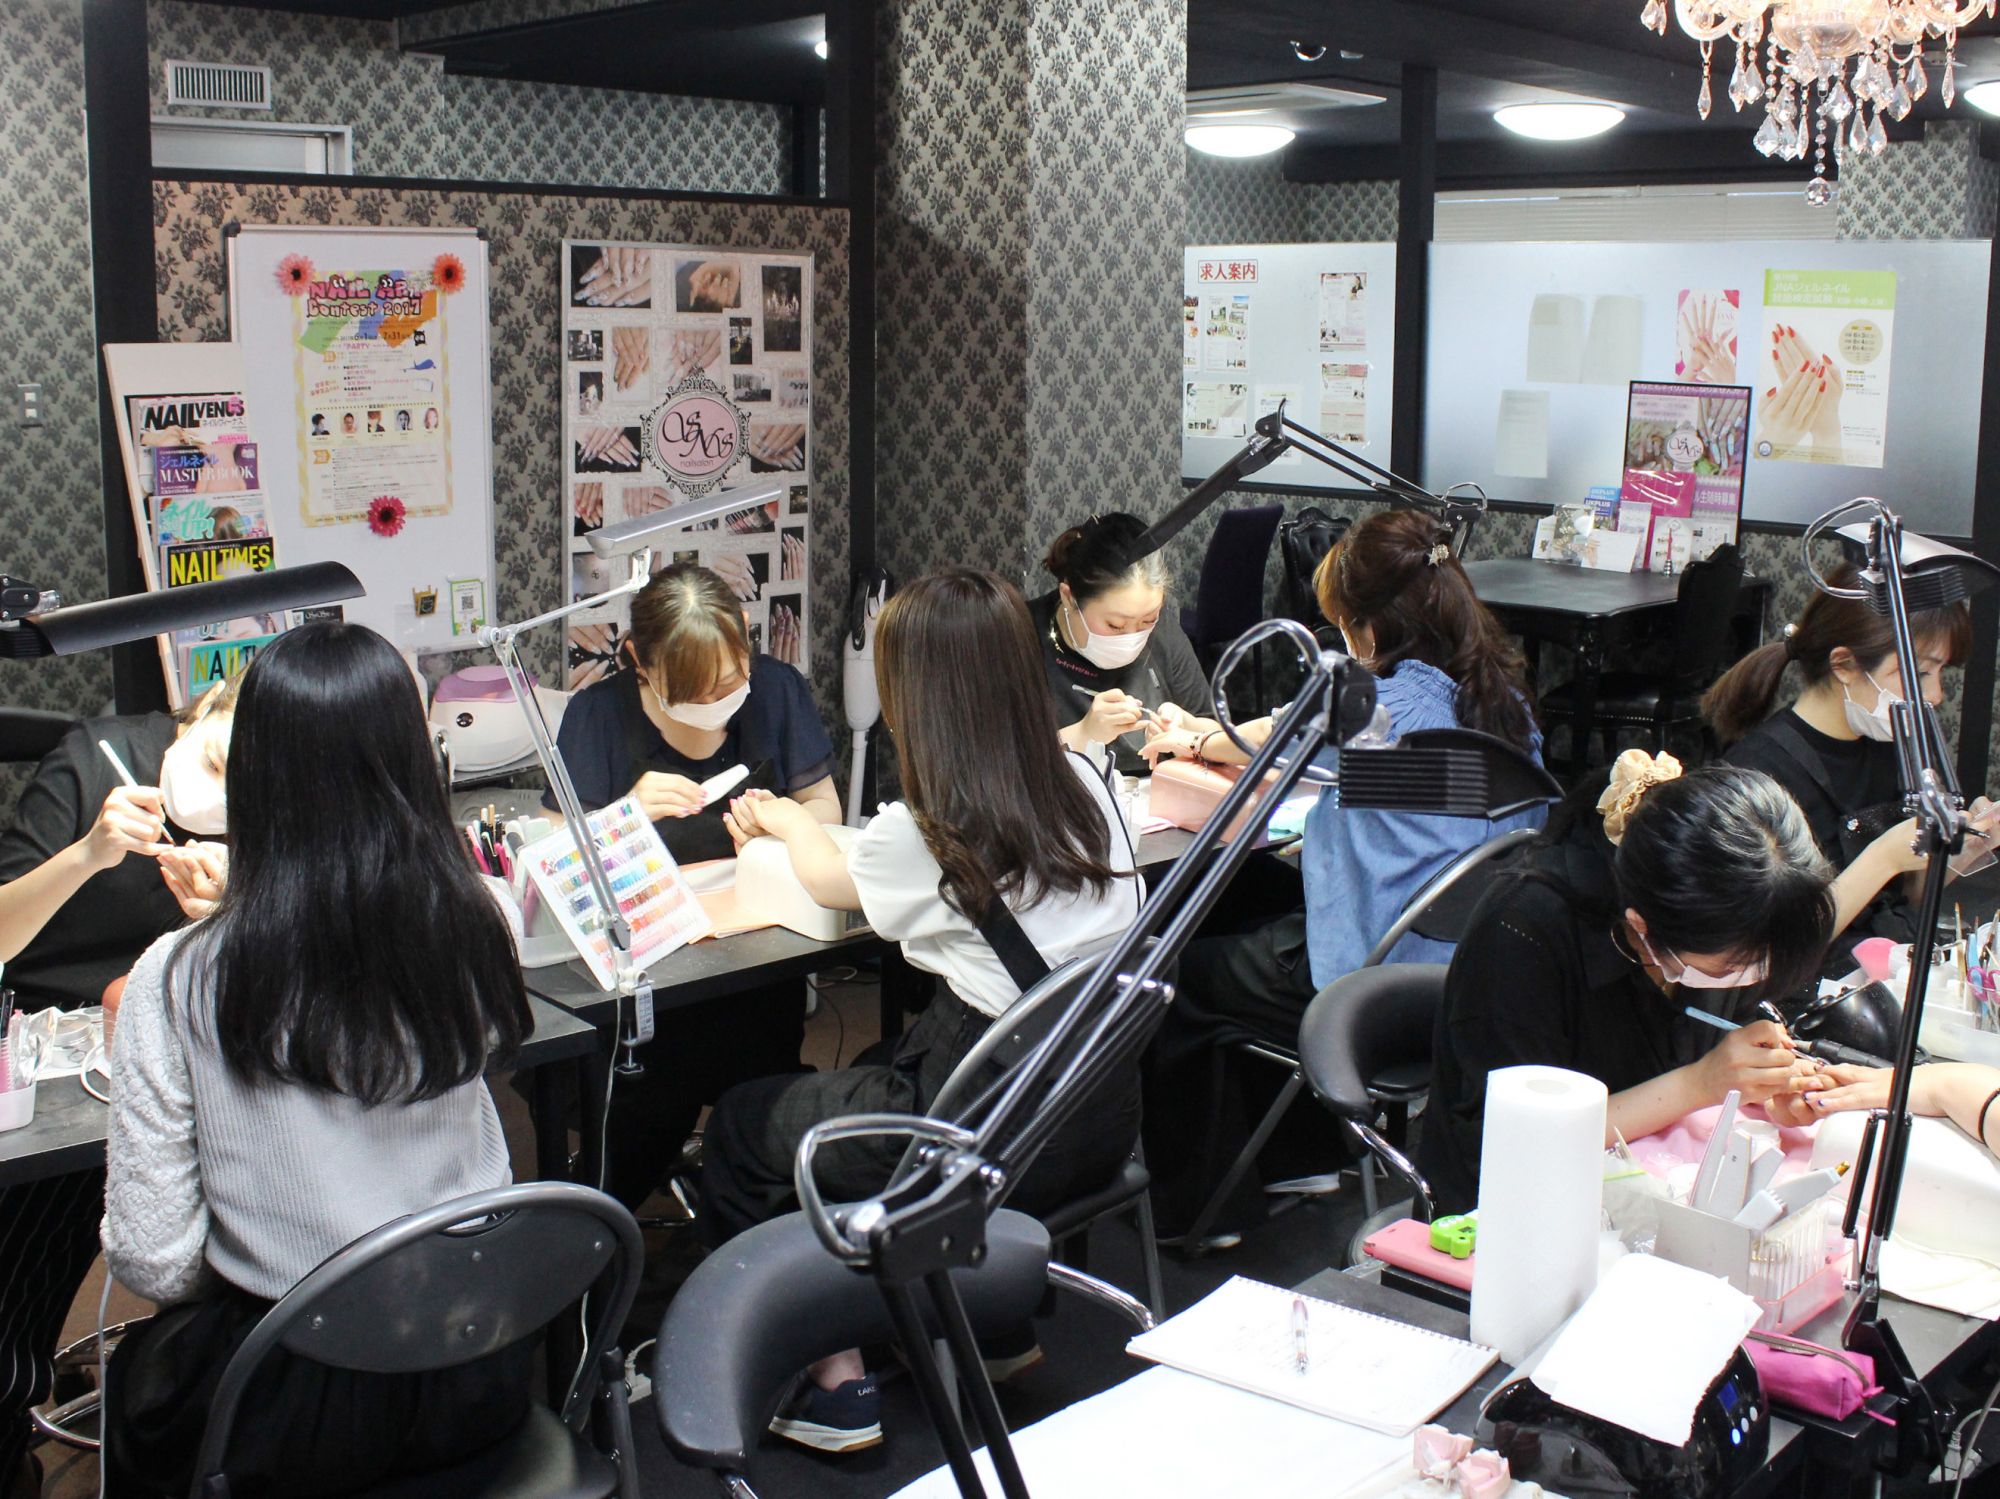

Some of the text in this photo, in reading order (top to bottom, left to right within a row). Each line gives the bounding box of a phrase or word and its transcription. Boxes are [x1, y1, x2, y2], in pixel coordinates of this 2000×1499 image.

[1200, 263, 1256, 279] 求人案内
[309, 274, 371, 300] NAIL
[307, 299, 378, 317] Contest
[145, 400, 244, 430] NAIL VENUS
[160, 453, 218, 468] ジェルネイル
[160, 464, 254, 483] MASTER BOOK
[170, 544, 271, 586] NAIL TIMES
